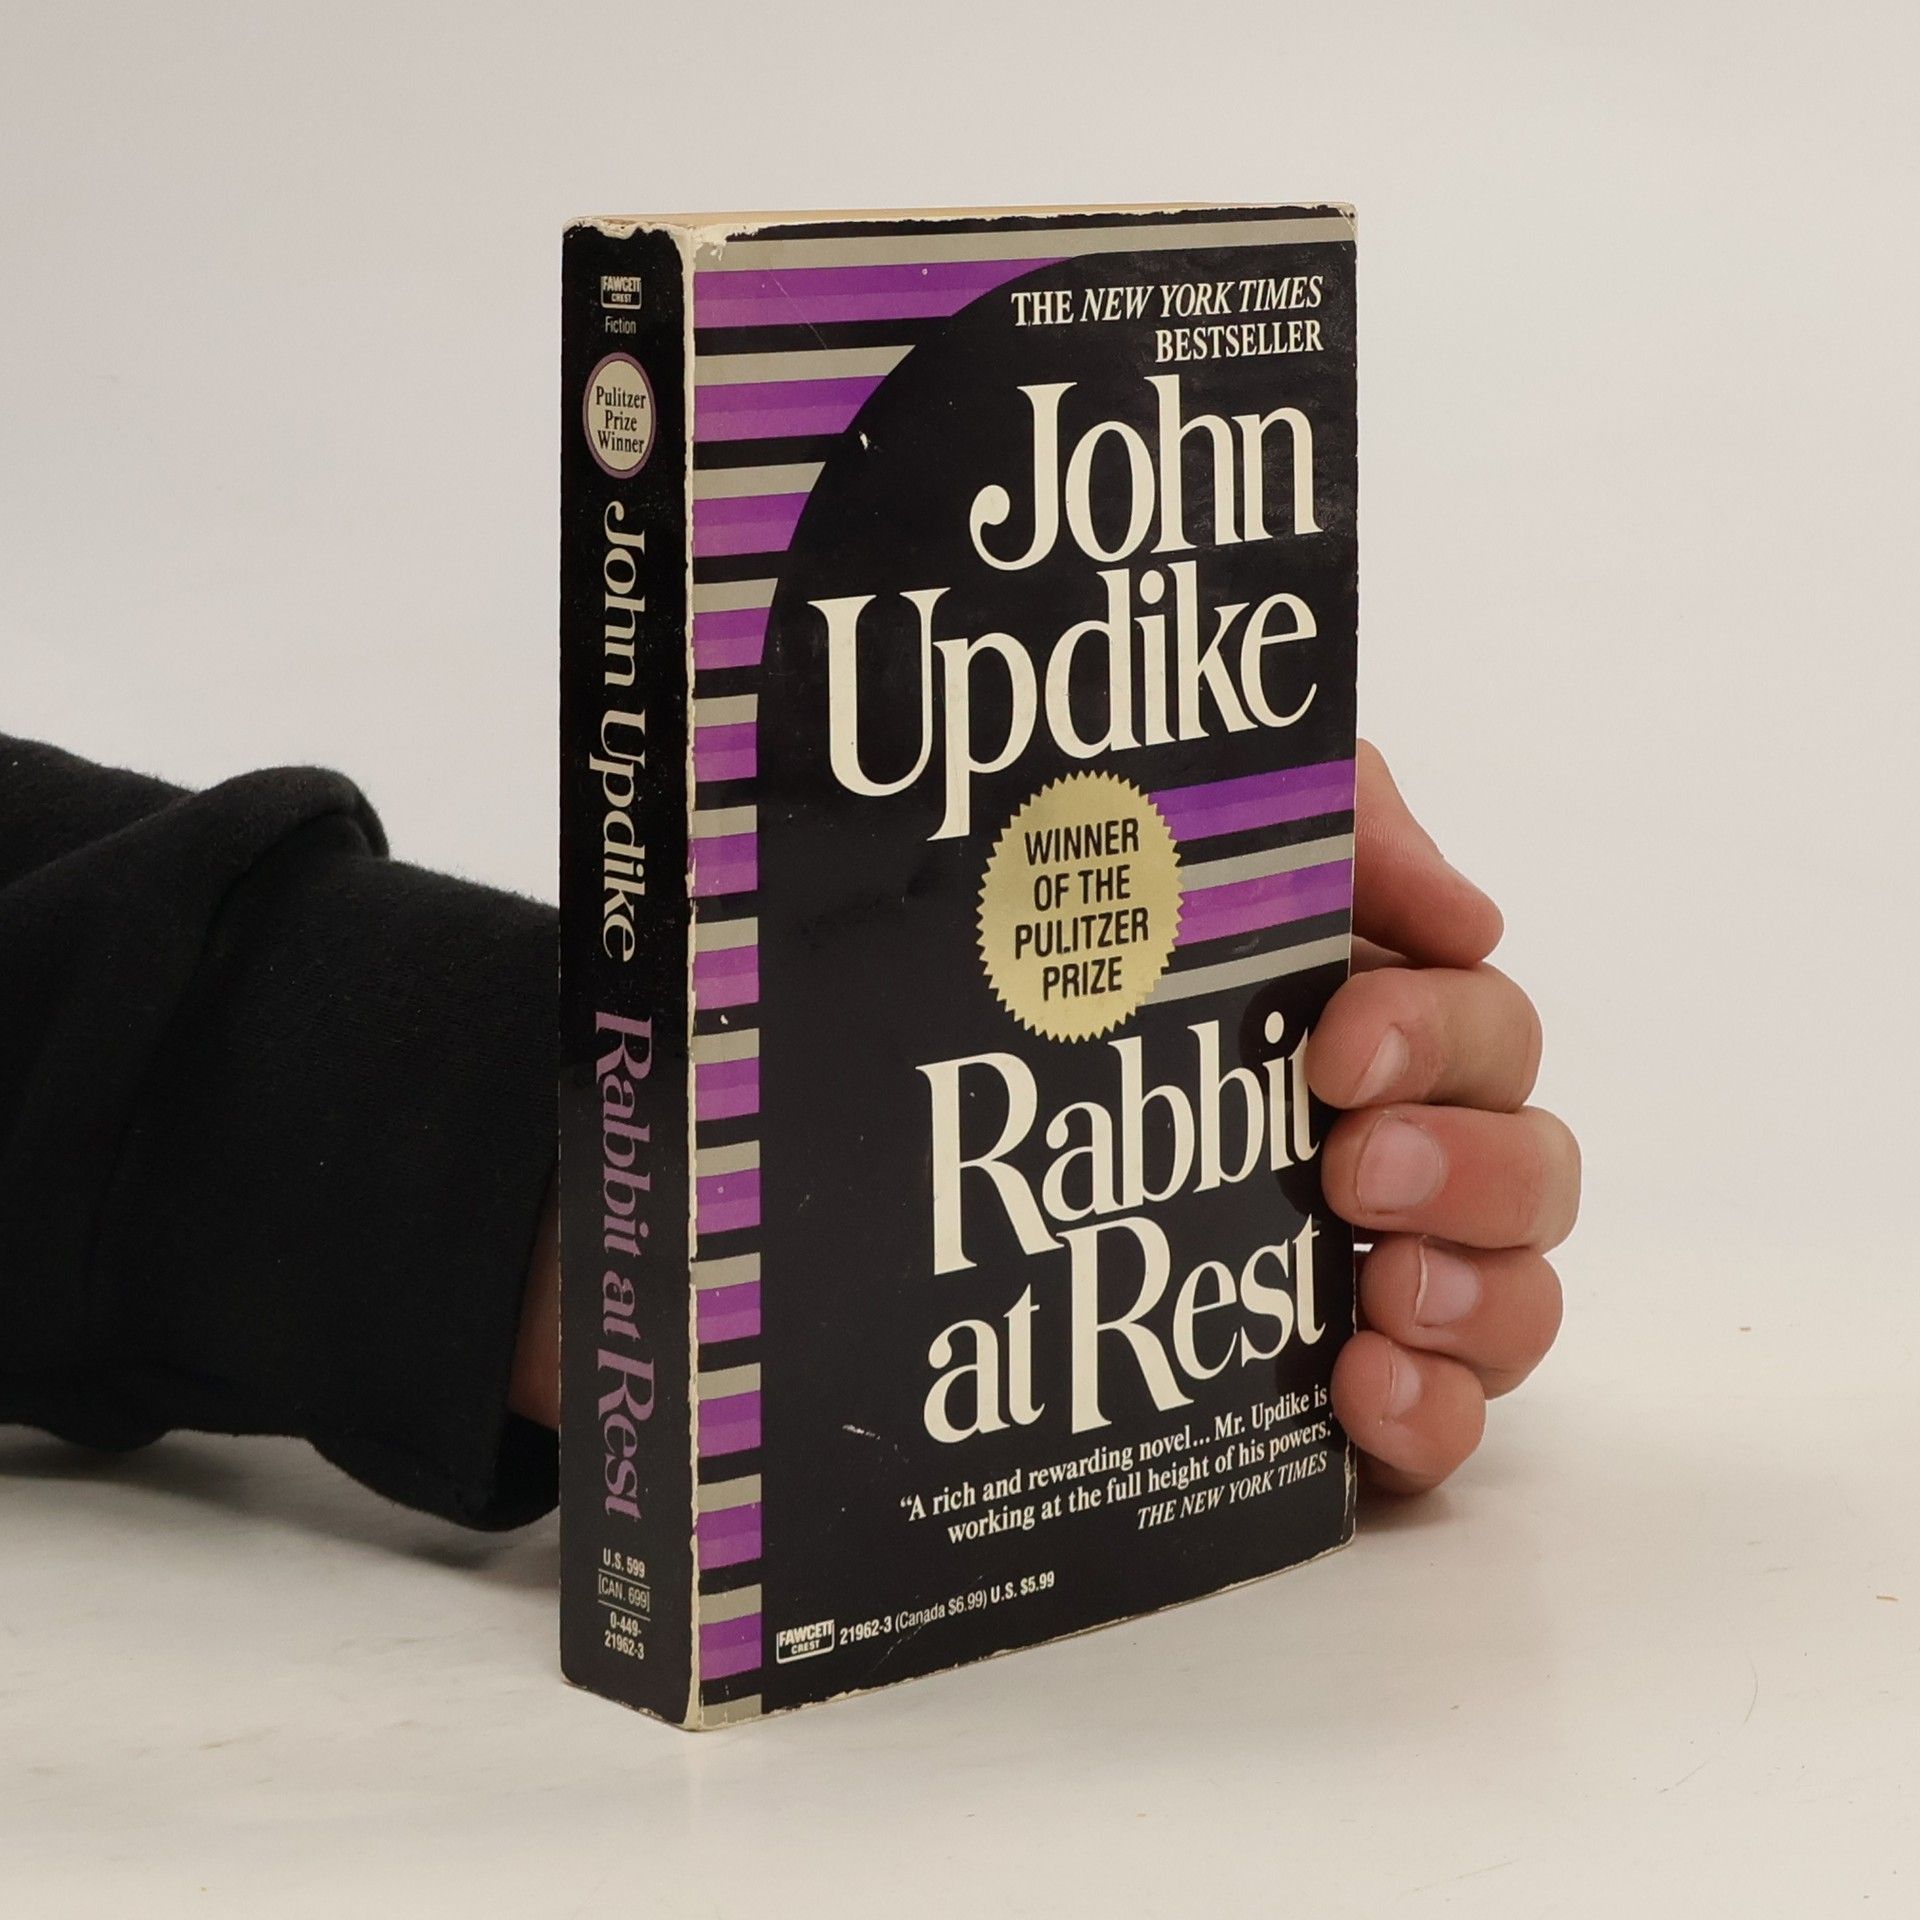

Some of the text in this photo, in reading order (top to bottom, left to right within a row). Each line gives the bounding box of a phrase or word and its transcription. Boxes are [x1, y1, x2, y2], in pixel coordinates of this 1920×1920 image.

[602, 276, 641, 292] FAWCETT
[611, 292, 632, 303] CREST
[1011, 275, 1323, 327] THE NEW YORK TIMES
[605, 316, 637, 335] Fiction
[1156, 320, 1324, 362] BESTSELLER
[596, 386, 646, 409] Pulitzer
[605, 410, 638, 432] Prize
[598, 430, 645, 453] Winner
[969, 374, 1323, 571] John
[807, 560, 1318, 841] Updike
[589, 501, 645, 963] John Updike
[1024, 818, 1140, 865] WINNER
[1033, 865, 1131, 912] OF THE
[1014, 906, 1149, 959] PULITZER
[1041, 957, 1123, 1002] PRIZE
[916, 1010, 1320, 1276] Rabbit
[596, 1011, 655, 1520] Rabbit at Rest
[923, 1213, 1326, 1444] at Rest
[932, 1483, 977, 1516] rich
[982, 1468, 1023, 1501] and
[1028, 1446, 1134, 1490] rewarding
[1215, 1413, 1246, 1441] Mr.
[1251, 1394, 1310, 1431] Updike
[1314, 1384, 1328, 1407] is
[948, 1503, 1036, 1544] working
[1041, 1496, 1063, 1518] at
[1069, 1485, 1102, 1512] the
[1107, 1471, 1142, 1502] full
[1147, 1457, 1211, 1499] height
[1215, 1442, 1236, 1474] of
[1239, 1436, 1266, 1468] his
[1137, 1450, 1328, 1530] THE NEW YORK TIMES
[603, 1548, 646, 1579] U.S. 599
[609, 1611, 642, 1637] 0-449-
[840, 1570, 1056, 1646] 21962-3 (Canada $6.99) U.S. $5.99
[604, 1630, 645, 1660] 21962-3
[779, 1620, 835, 1646] FAWCETT
[791, 1639, 820, 1655] CREST
